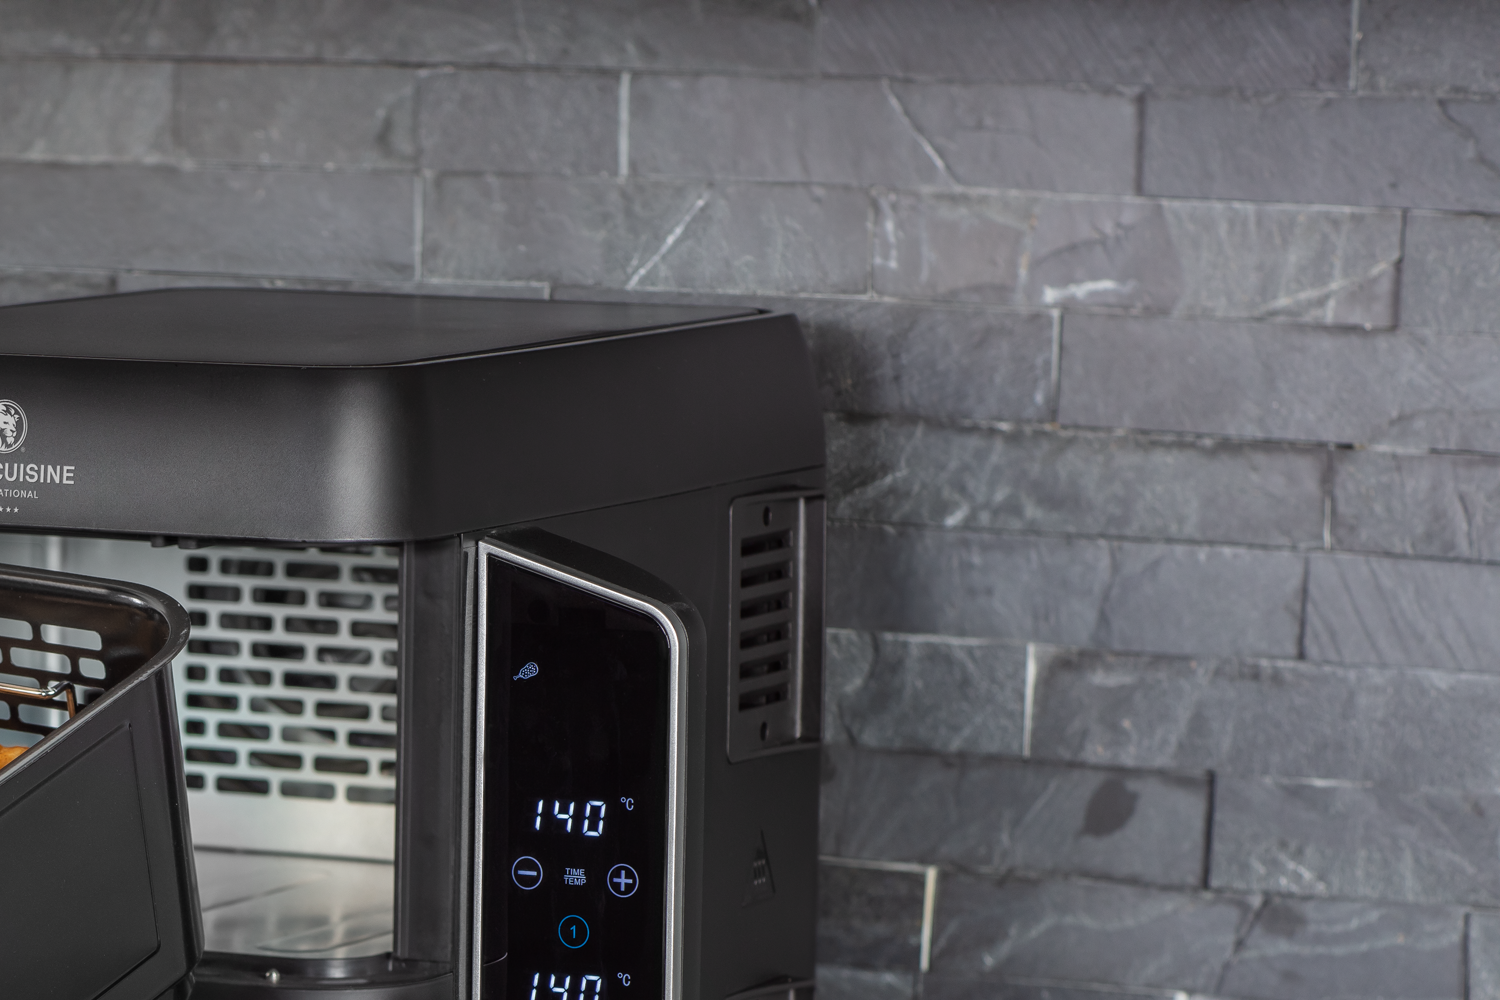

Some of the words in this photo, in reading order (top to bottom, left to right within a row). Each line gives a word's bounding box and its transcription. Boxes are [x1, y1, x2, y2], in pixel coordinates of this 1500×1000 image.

[534, 799, 606, 837] 140
[620, 796, 634, 811] °C
[565, 867, 585, 877] TIME
[563, 877, 587, 886] TEMP
[570, 925, 576, 939] 1
[617, 972, 631, 987] °C
